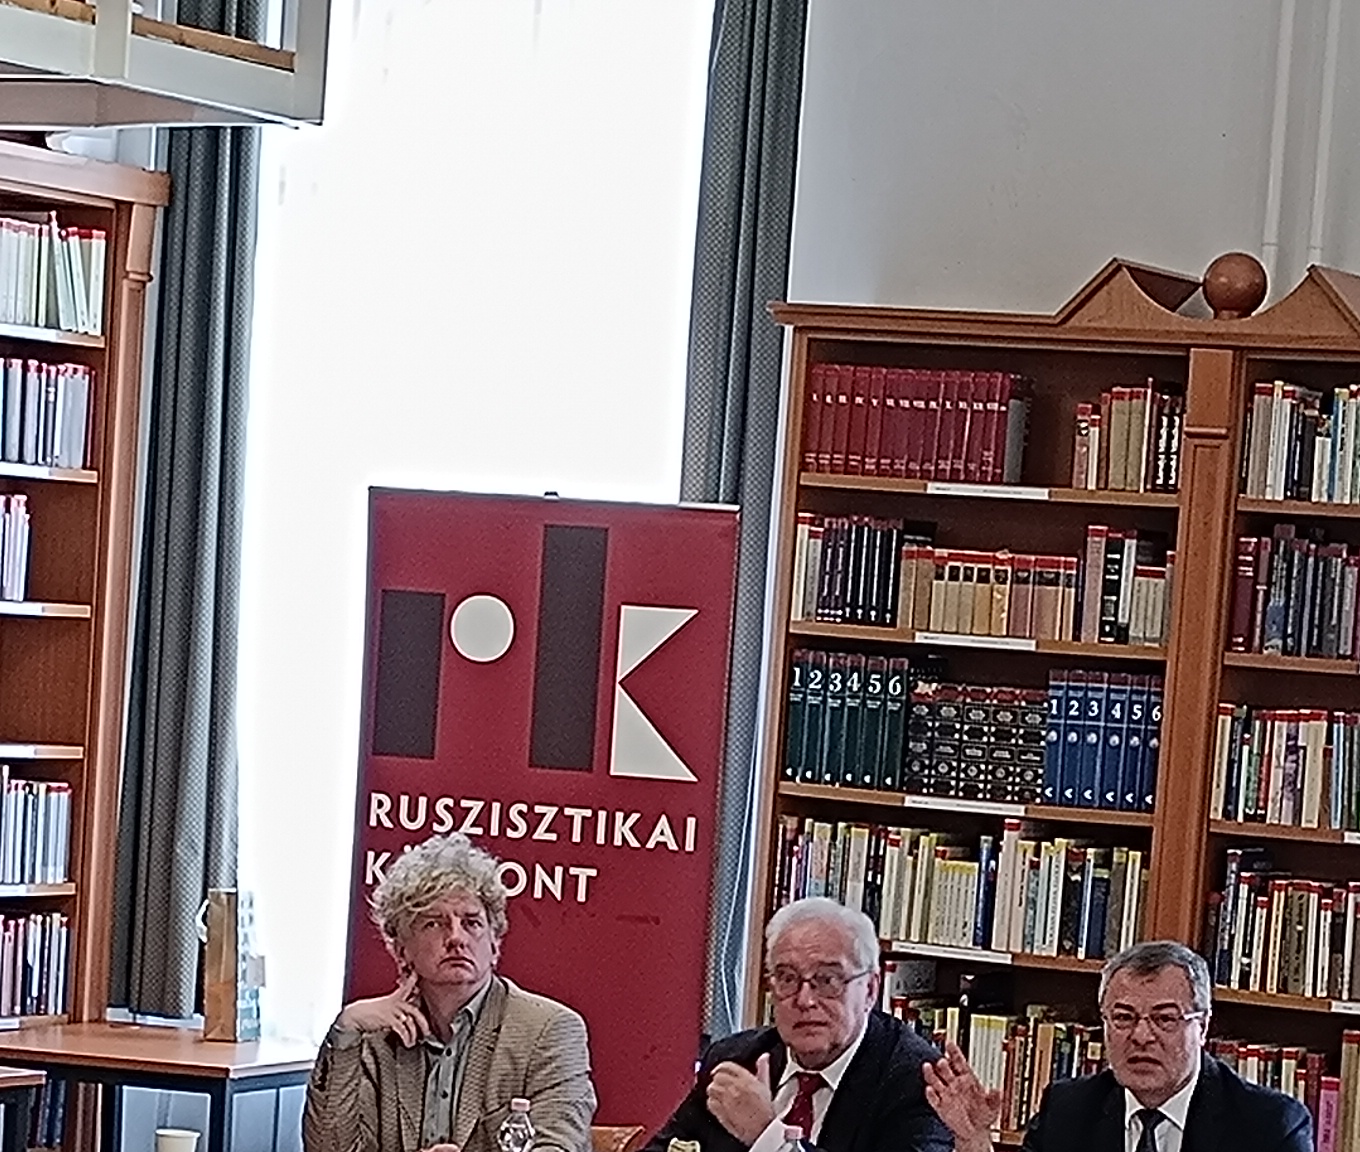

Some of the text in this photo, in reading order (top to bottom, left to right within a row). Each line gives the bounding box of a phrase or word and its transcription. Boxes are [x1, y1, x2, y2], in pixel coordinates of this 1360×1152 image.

[792, 667, 801, 687] 1
[809, 669, 822, 689] 2
[828, 672, 842, 693] 3
[846, 672, 861, 692] 4
[868, 674, 881, 694] 5
[888, 675, 902, 695] 6
[1050, 699, 1058, 715] 1
[1068, 700, 1079, 716] 2
[1088, 700, 1099, 717] 3
[1111, 702, 1121, 719] 4
[1131, 704, 1142, 720] 5
[1152, 705, 1162, 721] 6
[369, 792, 696, 851] RUSZISZTIKAI
[365, 848, 597, 903] KONT
